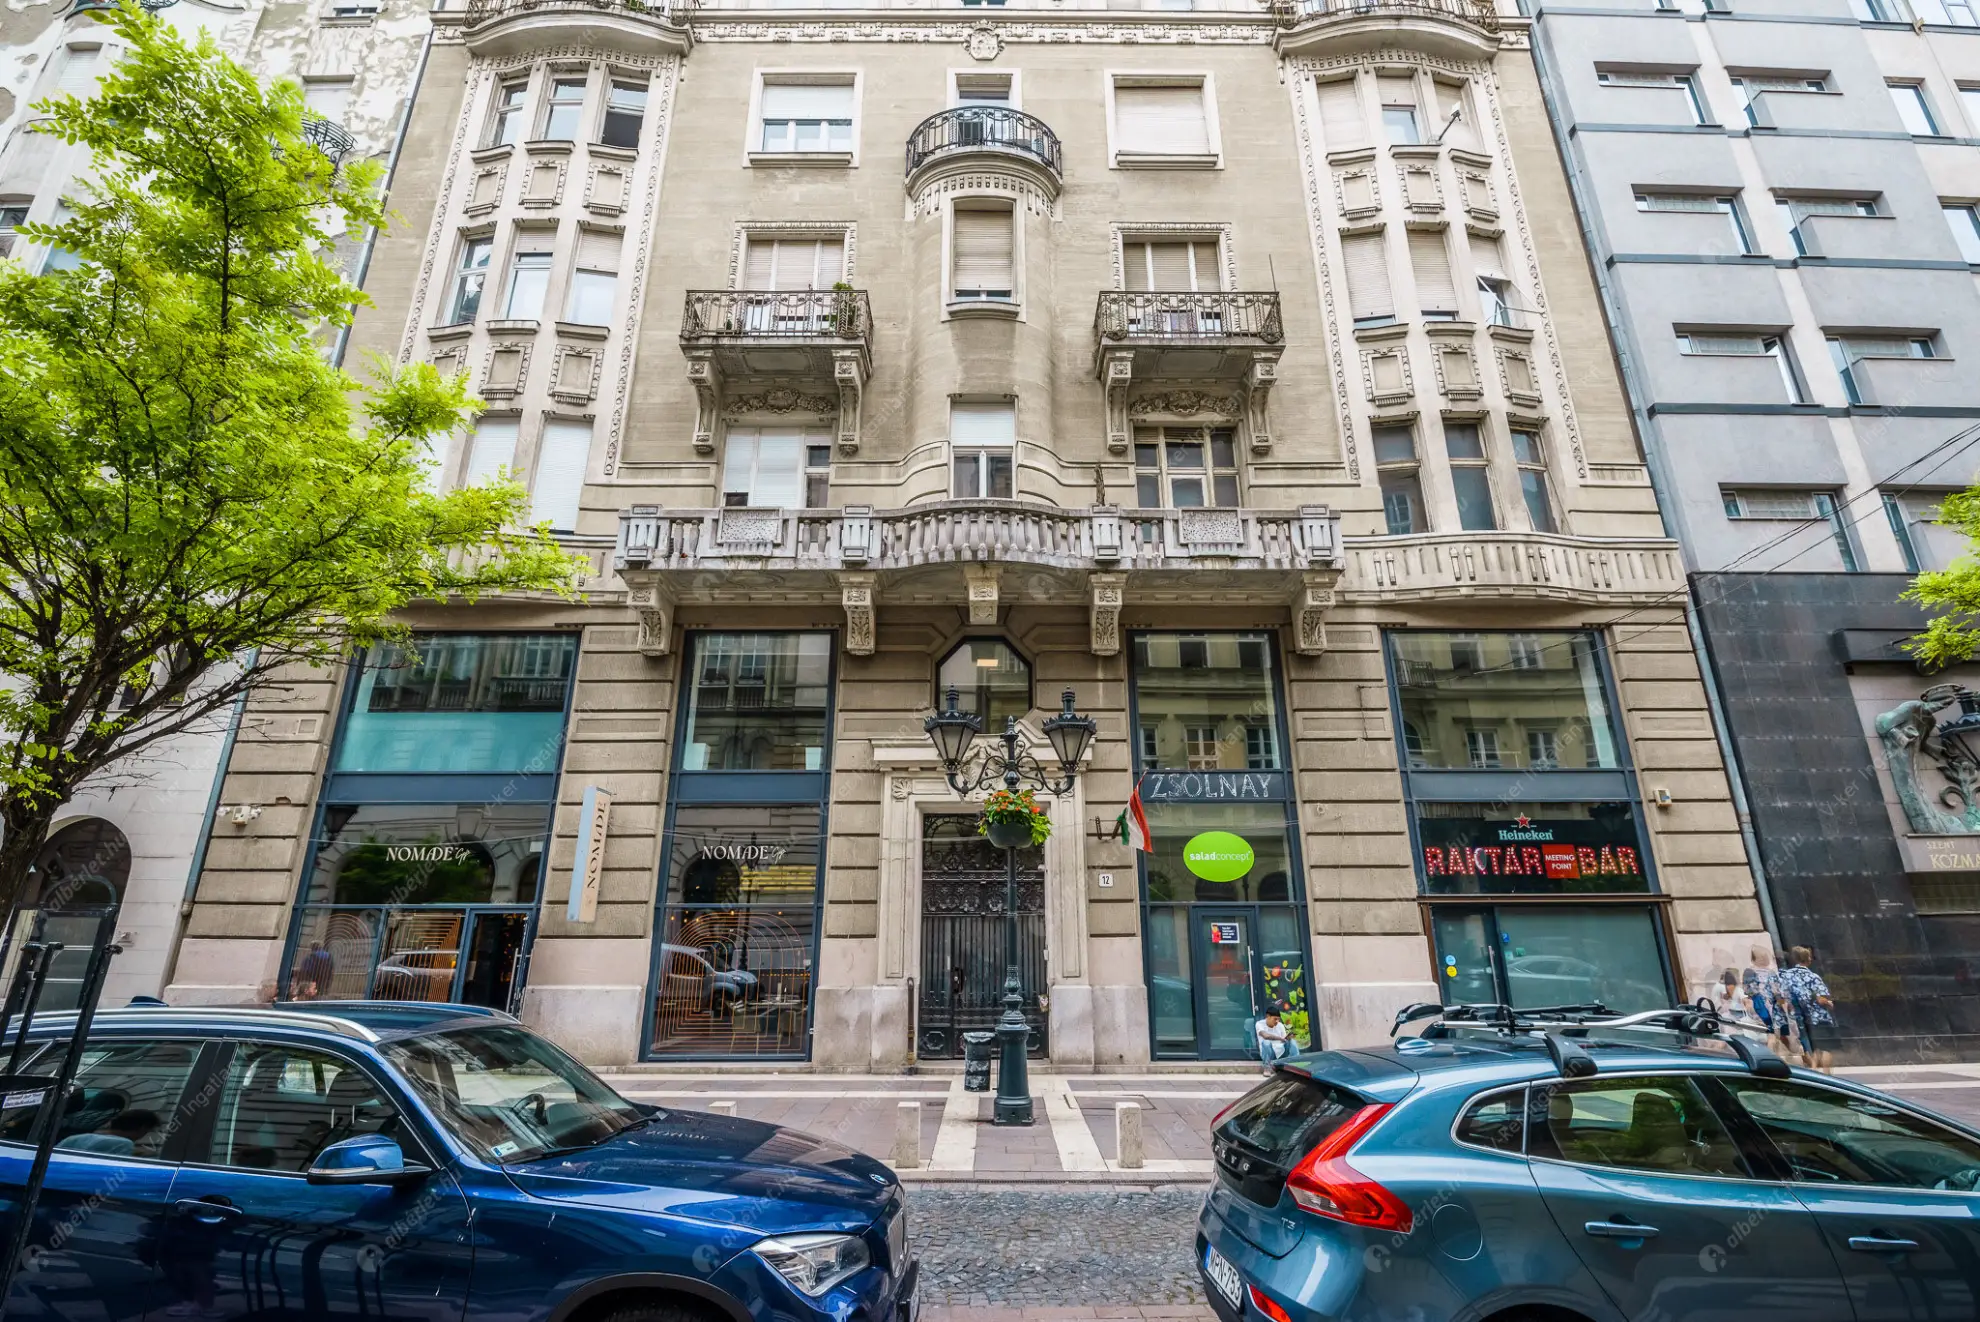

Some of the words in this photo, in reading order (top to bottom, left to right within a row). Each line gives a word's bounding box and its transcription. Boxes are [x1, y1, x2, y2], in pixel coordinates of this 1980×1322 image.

[1150, 773, 1272, 798] ZSOLNAY
[1498, 829, 1553, 840] Heineken
[587, 802, 606, 889] NOMADE
[702, 845, 769, 860] NOMADE
[386, 846, 454, 861] NOMADE
[1189, 851, 1250, 862] saladconcept
[1425, 844, 1544, 875] RAKTÁR
[1578, 844, 1640, 875] BÁR
[1101, 875, 1110, 885] 12
[1281, 1216, 1296, 1230] T3
